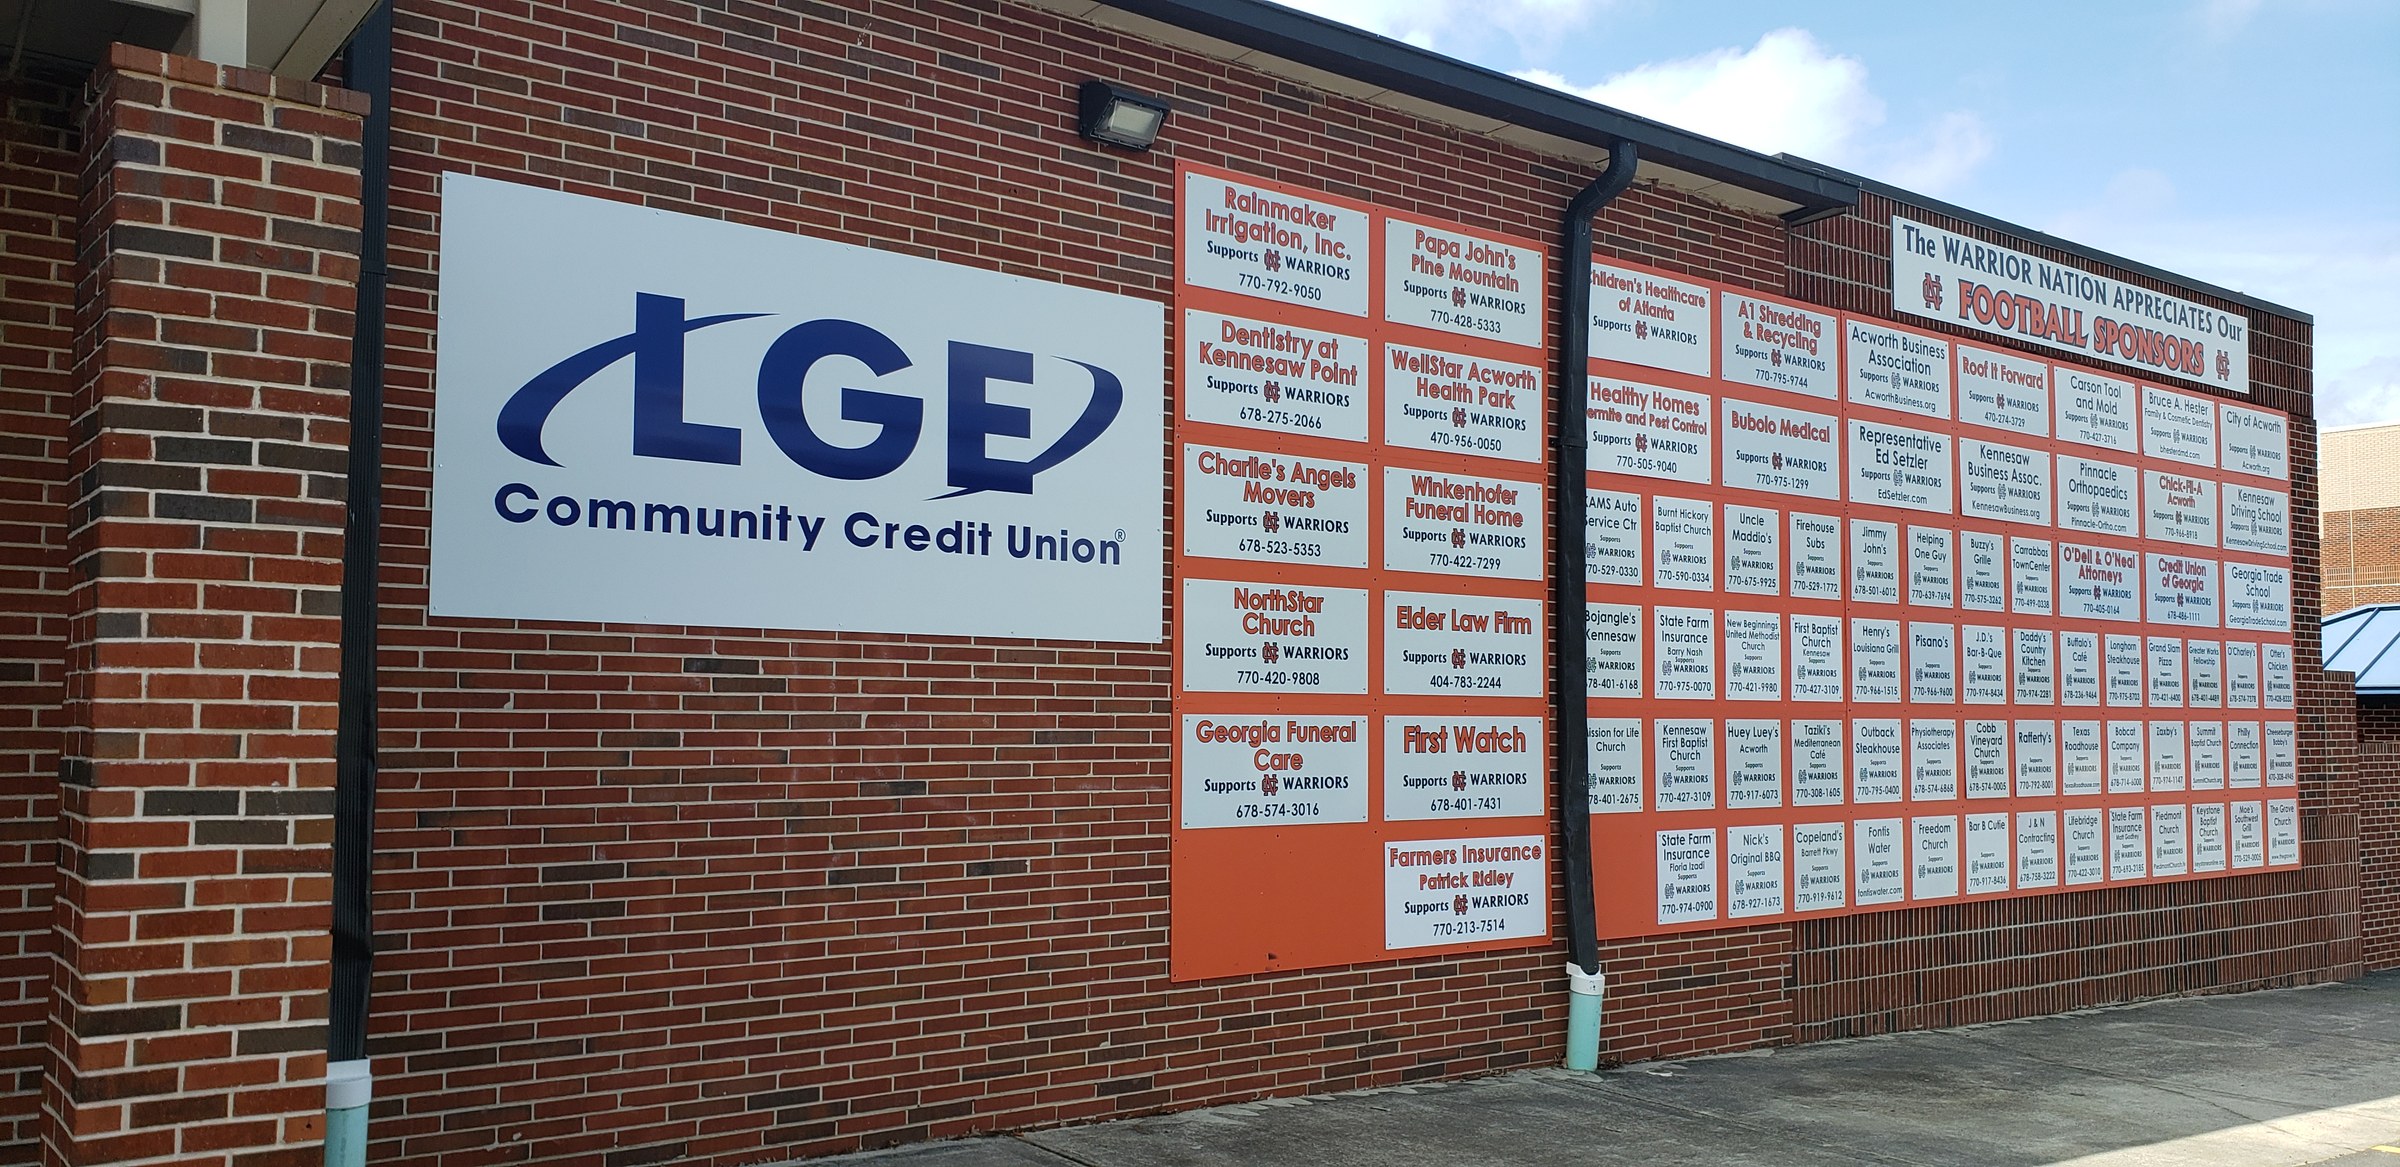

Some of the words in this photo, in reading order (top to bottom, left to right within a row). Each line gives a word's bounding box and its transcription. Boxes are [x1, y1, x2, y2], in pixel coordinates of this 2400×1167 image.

[1224, 185, 1336, 232] Rainmaker
[1205, 207, 1308, 254] Irrigation,
[1314, 231, 1351, 261] Inc.
[1206, 239, 1258, 262] Supports
[1284, 255, 1350, 281] WARRIORS
[1415, 228, 1460, 259] Papa
[1464, 240, 1516, 270] John's
[1411, 253, 1444, 277] Pine
[1448, 261, 1519, 293] Mountain
[1902, 224, 1936, 258] The
[1942, 234, 2032, 285] WARRIOR
[2038, 262, 2107, 305] NATION
[2114, 286, 2212, 334] APPRECIATES
[2217, 315, 2242, 342] Our
[1238, 272, 1321, 301] 770-792-9050
[1644, 280, 1706, 308] Healthcare
[1618, 296, 1631, 312] of
[1632, 298, 1674, 321] Atlanta
[1737, 300, 1754, 320] A1
[1758, 304, 1821, 336] Shredding
[1743, 320, 1754, 339] &
[1756, 322, 1818, 356] Recycling
[1958, 278, 2089, 349] FOOTBALL
[2093, 315, 2204, 377] SPONSORS
[1221, 319, 1314, 358] Dentistry
[1317, 337, 1338, 360] at
[1851, 325, 1898, 350] Acworth
[1901, 336, 1945, 360] Business
[1199, 340, 1306, 378] Kennesaw
[1310, 358, 1358, 386] Point
[1391, 348, 1463, 379] WellStar
[1467, 361, 1536, 391] Acworth
[1867, 348, 1931, 376] Association
[1962, 355, 1988, 378] Roof
[1990, 361, 1998, 380] It
[2000, 364, 2043, 390] Forward
[1755, 368, 1808, 388] 770-795-9744
[2070, 375, 2102, 394] Carson
[2103, 382, 2121, 398] Tool
[633, 292, 1034, 494] LGE
[1416, 376, 1472, 404] Health
[1478, 385, 1516, 410] Park
[1590, 381, 1649, 412] Healthy
[1652, 390, 1699, 416] Homes
[1864, 388, 1936, 413] AcworthBusiness.org
[2148, 391, 2172, 408] Bruce
[2173, 396, 2182, 411] A.
[2184, 398, 2208, 416] Hester
[2075, 396, 2093, 410] and
[2095, 398, 2117, 415] Mold
[1239, 406, 1322, 429] 678-275-2066
[1587, 406, 1622, 422] ermite
[1624, 411, 1646, 426] and
[1648, 413, 1670, 430] Pest
[1671, 416, 1707, 435] Control
[1731, 410, 1776, 434] Bubolo
[1779, 418, 1830, 443] Medical
[1984, 411, 2025, 427] 470-274-3729
[2226, 410, 2242, 428] City
[2243, 414, 2251, 427] of
[2252, 415, 2281, 433] Acworth
[1859, 425, 1941, 453] Representative
[1616, 454, 1677, 473] 770-505-9040
[1875, 447, 1889, 464] Ed
[1892, 450, 1928, 470] Setzler
[1979, 444, 2030, 466] Kennesaw
[1198, 450, 1285, 481] Charlie's
[1289, 461, 1356, 489] Angels
[1756, 472, 1809, 490] 770-975-1299
[1967, 460, 2008, 481] Business
[2010, 467, 2042, 486] Assoc.
[2079, 462, 2117, 481] Pinnacle
[1243, 480, 1316, 508] Movers
[1410, 474, 1518, 505] Winkenhofer
[1877, 488, 1927, 504] EdSetzler.com
[2068, 478, 2128, 500] Orthopaedics
[2166, 491, 2196, 508] Acworth
[2237, 488, 2275, 506] Kennesaw
[494, 482, 825, 551] Community
[845, 512, 991, 557] Credit
[1405, 496, 1469, 523] Funeral
[1473, 503, 1523, 528] Home
[1679, 508, 1709, 523] Hickory
[1739, 512, 1764, 526] Uncle
[1971, 500, 2040, 520] KennesawBusiness.org
[2230, 503, 2256, 520] Driving
[2257, 507, 2281, 523] School
[1655, 520, 1681, 534] Baptist
[1731, 528, 1772, 544] Maddio's
[1796, 518, 1834, 534] Firehouse
[1861, 526, 1887, 541] Jimmy
[1970, 537, 1994, 552] Buzzy's
[2063, 546, 2092, 564] O'Dell
[2095, 550, 2102, 565] &
[2104, 550, 2135, 569] O'Neal
[2158, 557, 2183, 574] Credit
[2184, 560, 2206, 576] Union
[2078, 564, 2122, 586] Attorneys
[2161, 573, 2170, 588] of
[2171, 574, 2204, 594] Georgia
[2231, 565, 2262, 584] Georgia
[2262, 569, 2283, 584] Trade
[1234, 586, 1324, 613] NorthStar
[2245, 583, 2270, 598] School
[1242, 611, 1314, 637] Church
[1396, 605, 1446, 630] Elder
[1451, 608, 1489, 632] Law
[1494, 610, 1532, 635] Firm
[1661, 630, 1708, 644] Insurance
[1862, 625, 1890, 639] Henry's
[1915, 634, 1948, 648] Pisano's
[1429, 674, 1501, 689] 404-783-2244
[1195, 719, 1280, 748] Georgia
[1286, 720, 1356, 743] Funeral
[1403, 724, 1448, 754] First
[1452, 725, 1526, 753] Watch
[2018, 730, 2052, 746] Rafferty's
[1253, 748, 1303, 771] Care
[1236, 802, 1319, 818] 678-574-3016
[1389, 847, 1457, 867] Farmers
[1462, 844, 1541, 863] Insurance
[1419, 871, 1469, 890] Patrick
[1472, 869, 1514, 888] Ridley
[1432, 917, 1504, 936] 770-213-7514
